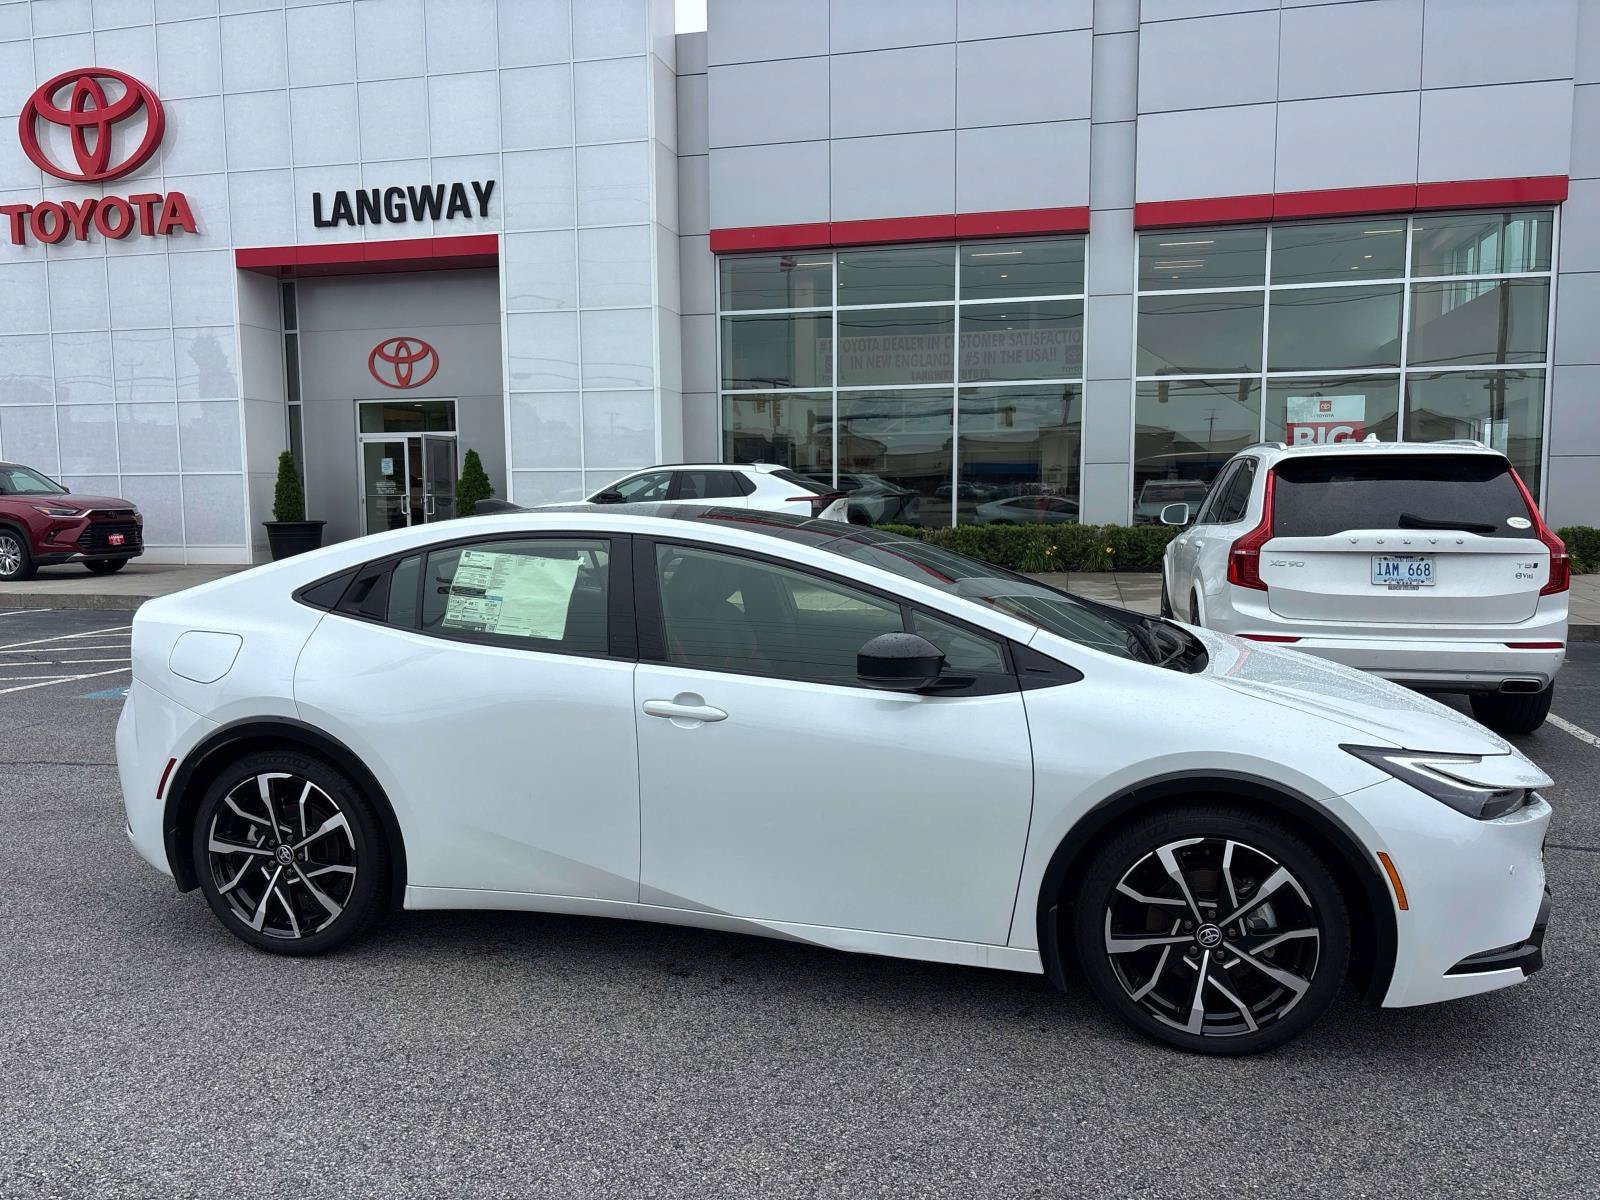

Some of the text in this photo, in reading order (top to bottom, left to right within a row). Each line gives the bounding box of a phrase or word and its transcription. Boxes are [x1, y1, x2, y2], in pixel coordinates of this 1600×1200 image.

[312, 180, 495, 228] LANGWAY
[0, 191, 199, 245] TOYOTA
[882, 336, 924, 352] DEALER
[926, 335, 940, 350] IN
[850, 355, 863, 369] IN
[866, 353, 893, 369] NEW
[983, 350, 996, 365] IN
[999, 349, 1023, 364] THE
[1407, 563, 1431, 577] 668
